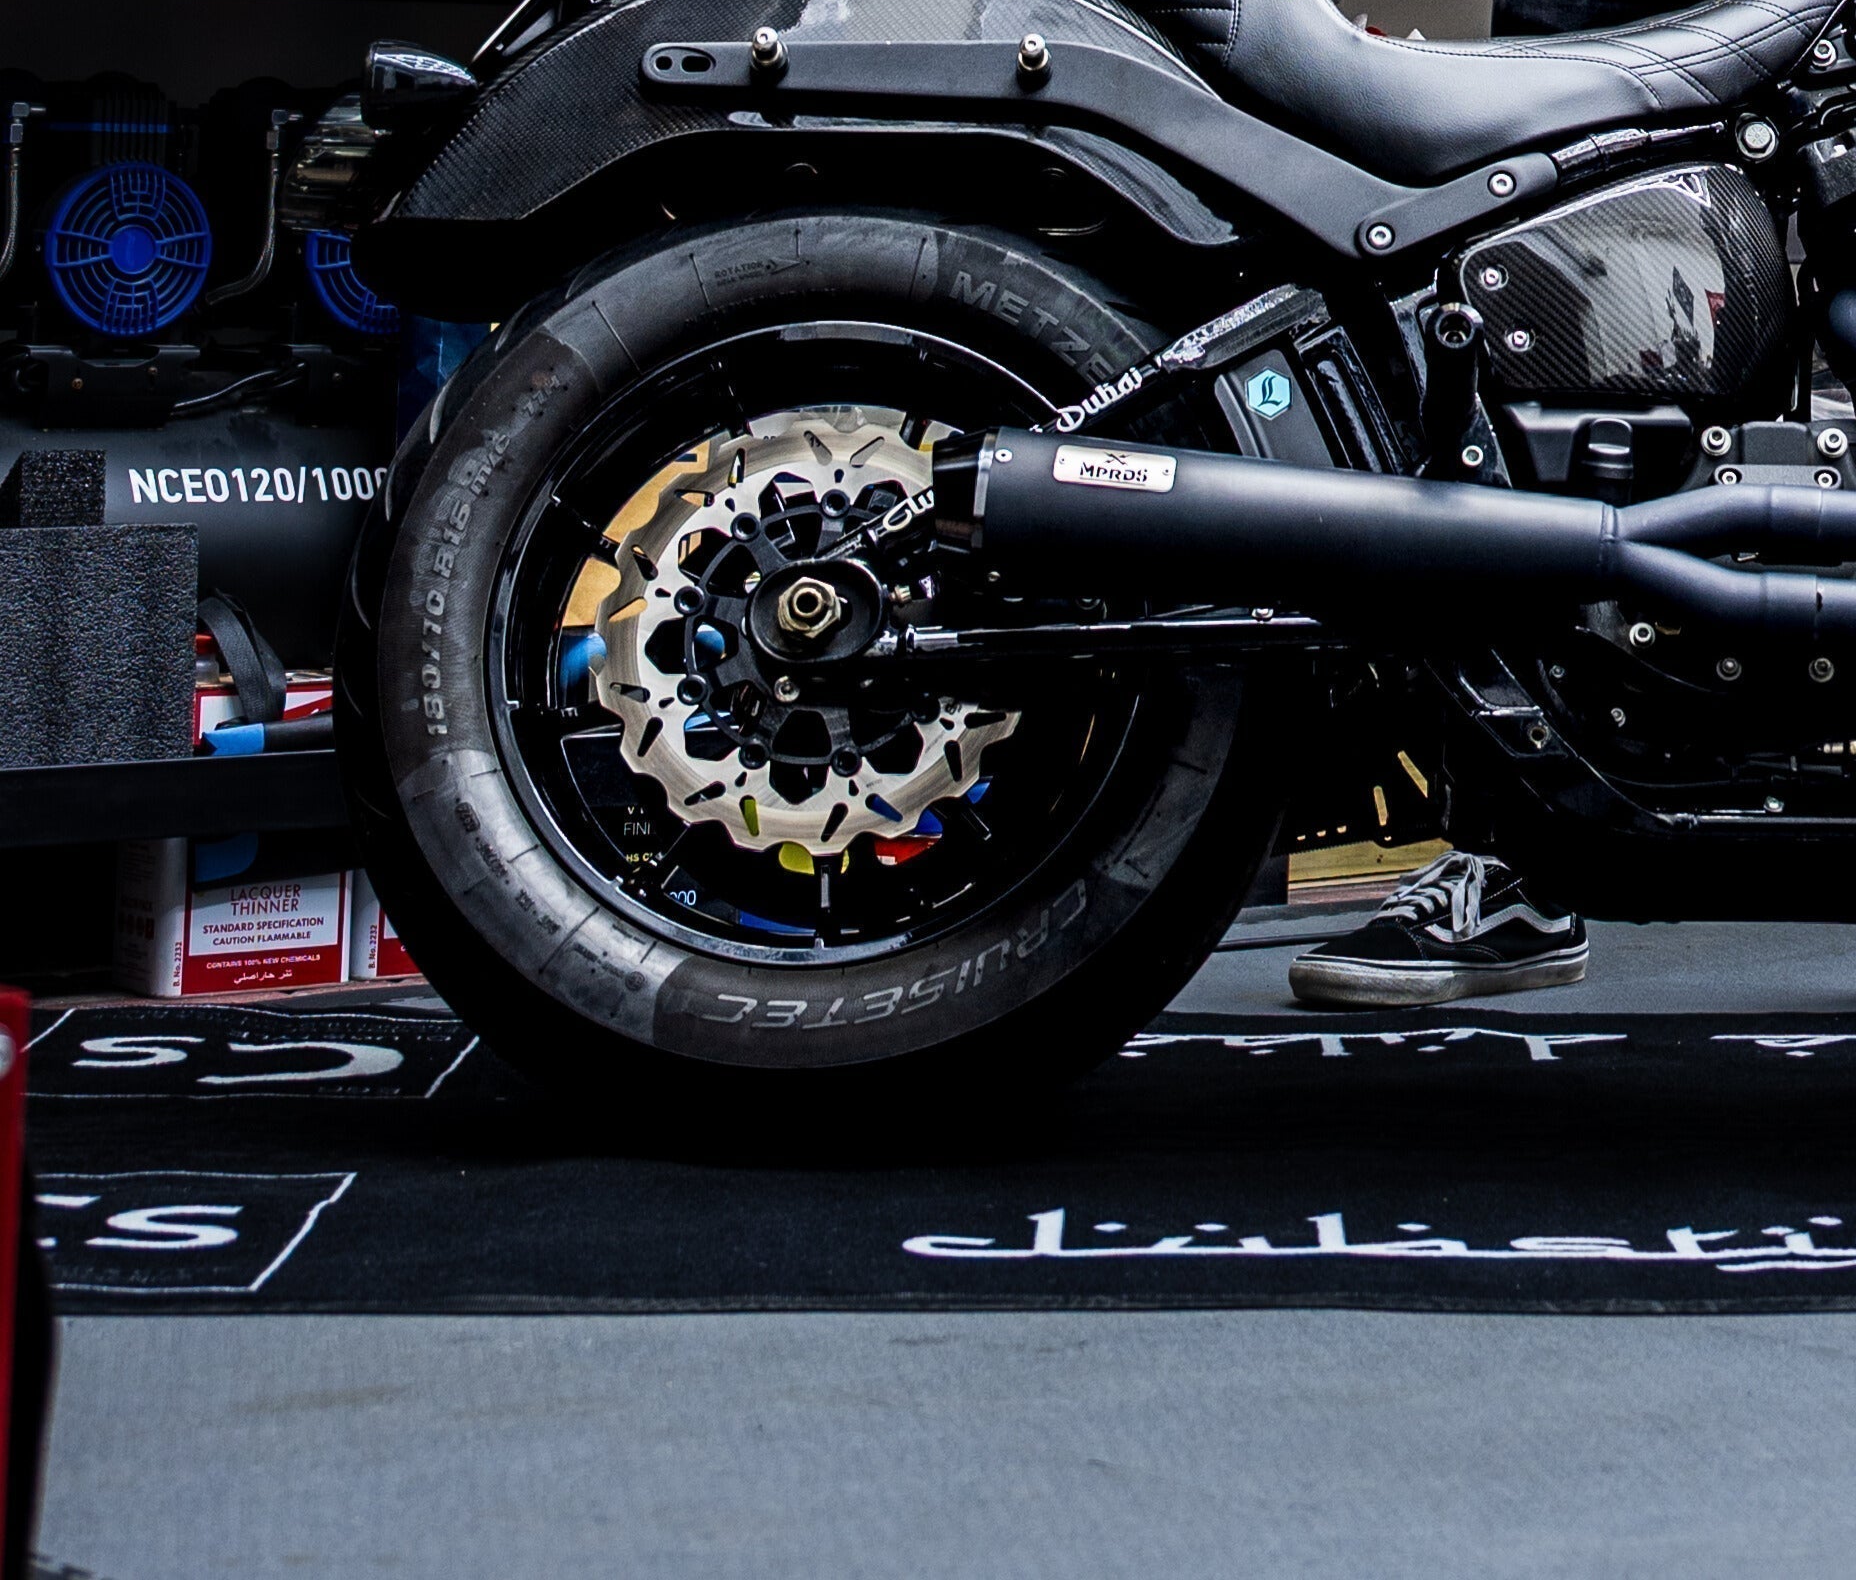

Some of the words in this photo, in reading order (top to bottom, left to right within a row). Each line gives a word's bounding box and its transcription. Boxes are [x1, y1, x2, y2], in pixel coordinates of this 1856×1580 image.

[1055, 367, 1144, 434] Dubai
[1079, 461, 1149, 483] MPRDS
[230, 883, 302, 902] LACQUER
[230, 898, 300, 917] THINNER
[202, 921, 256, 935] STANDARD
[256, 916, 325, 931] SPECIFICATION
[212, 935, 256, 946] CAUTION
[257, 931, 312, 943] FLAMMABLE
[206, 960, 242, 970] CONTAINS
[262, 956, 280, 965] NEW
[280, 953, 321, 963] CHEMICALS
[701, 878, 1087, 1029] CRUISETEC
